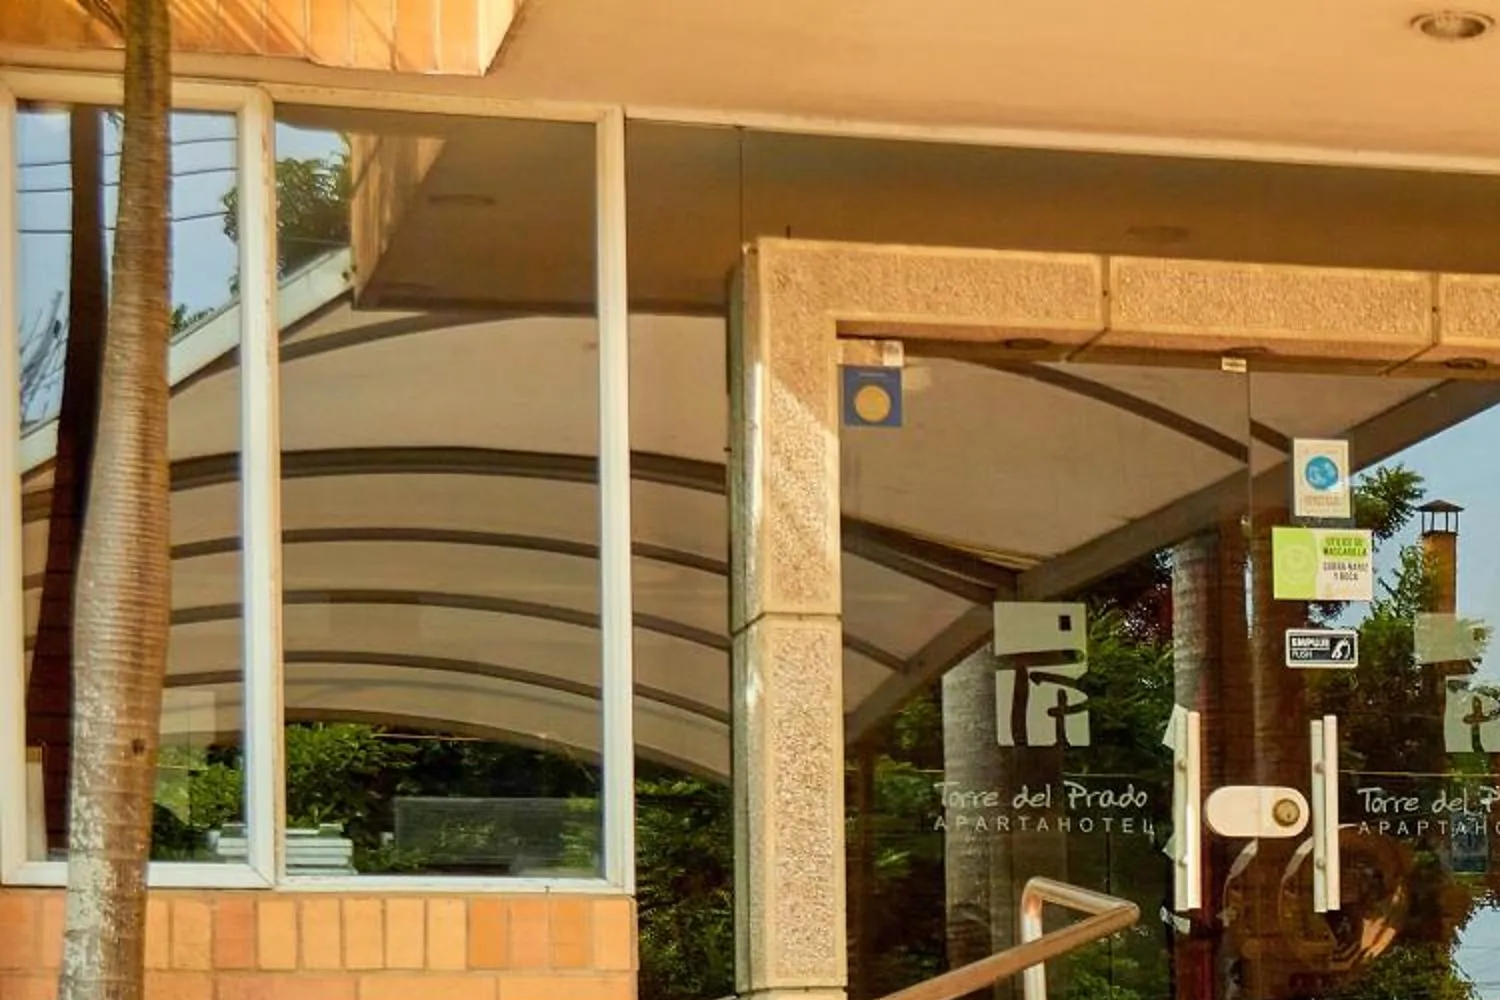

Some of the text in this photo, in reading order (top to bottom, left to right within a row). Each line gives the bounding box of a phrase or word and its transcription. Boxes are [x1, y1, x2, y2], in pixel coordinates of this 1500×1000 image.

[1291, 650, 1313, 659] PUSH
[933, 780, 1148, 810] Torre del Prado
[1356, 786, 1420, 813] Torre
[1431, 788, 1473, 816] del
[933, 815, 1155, 834] APARTAHOTEL
